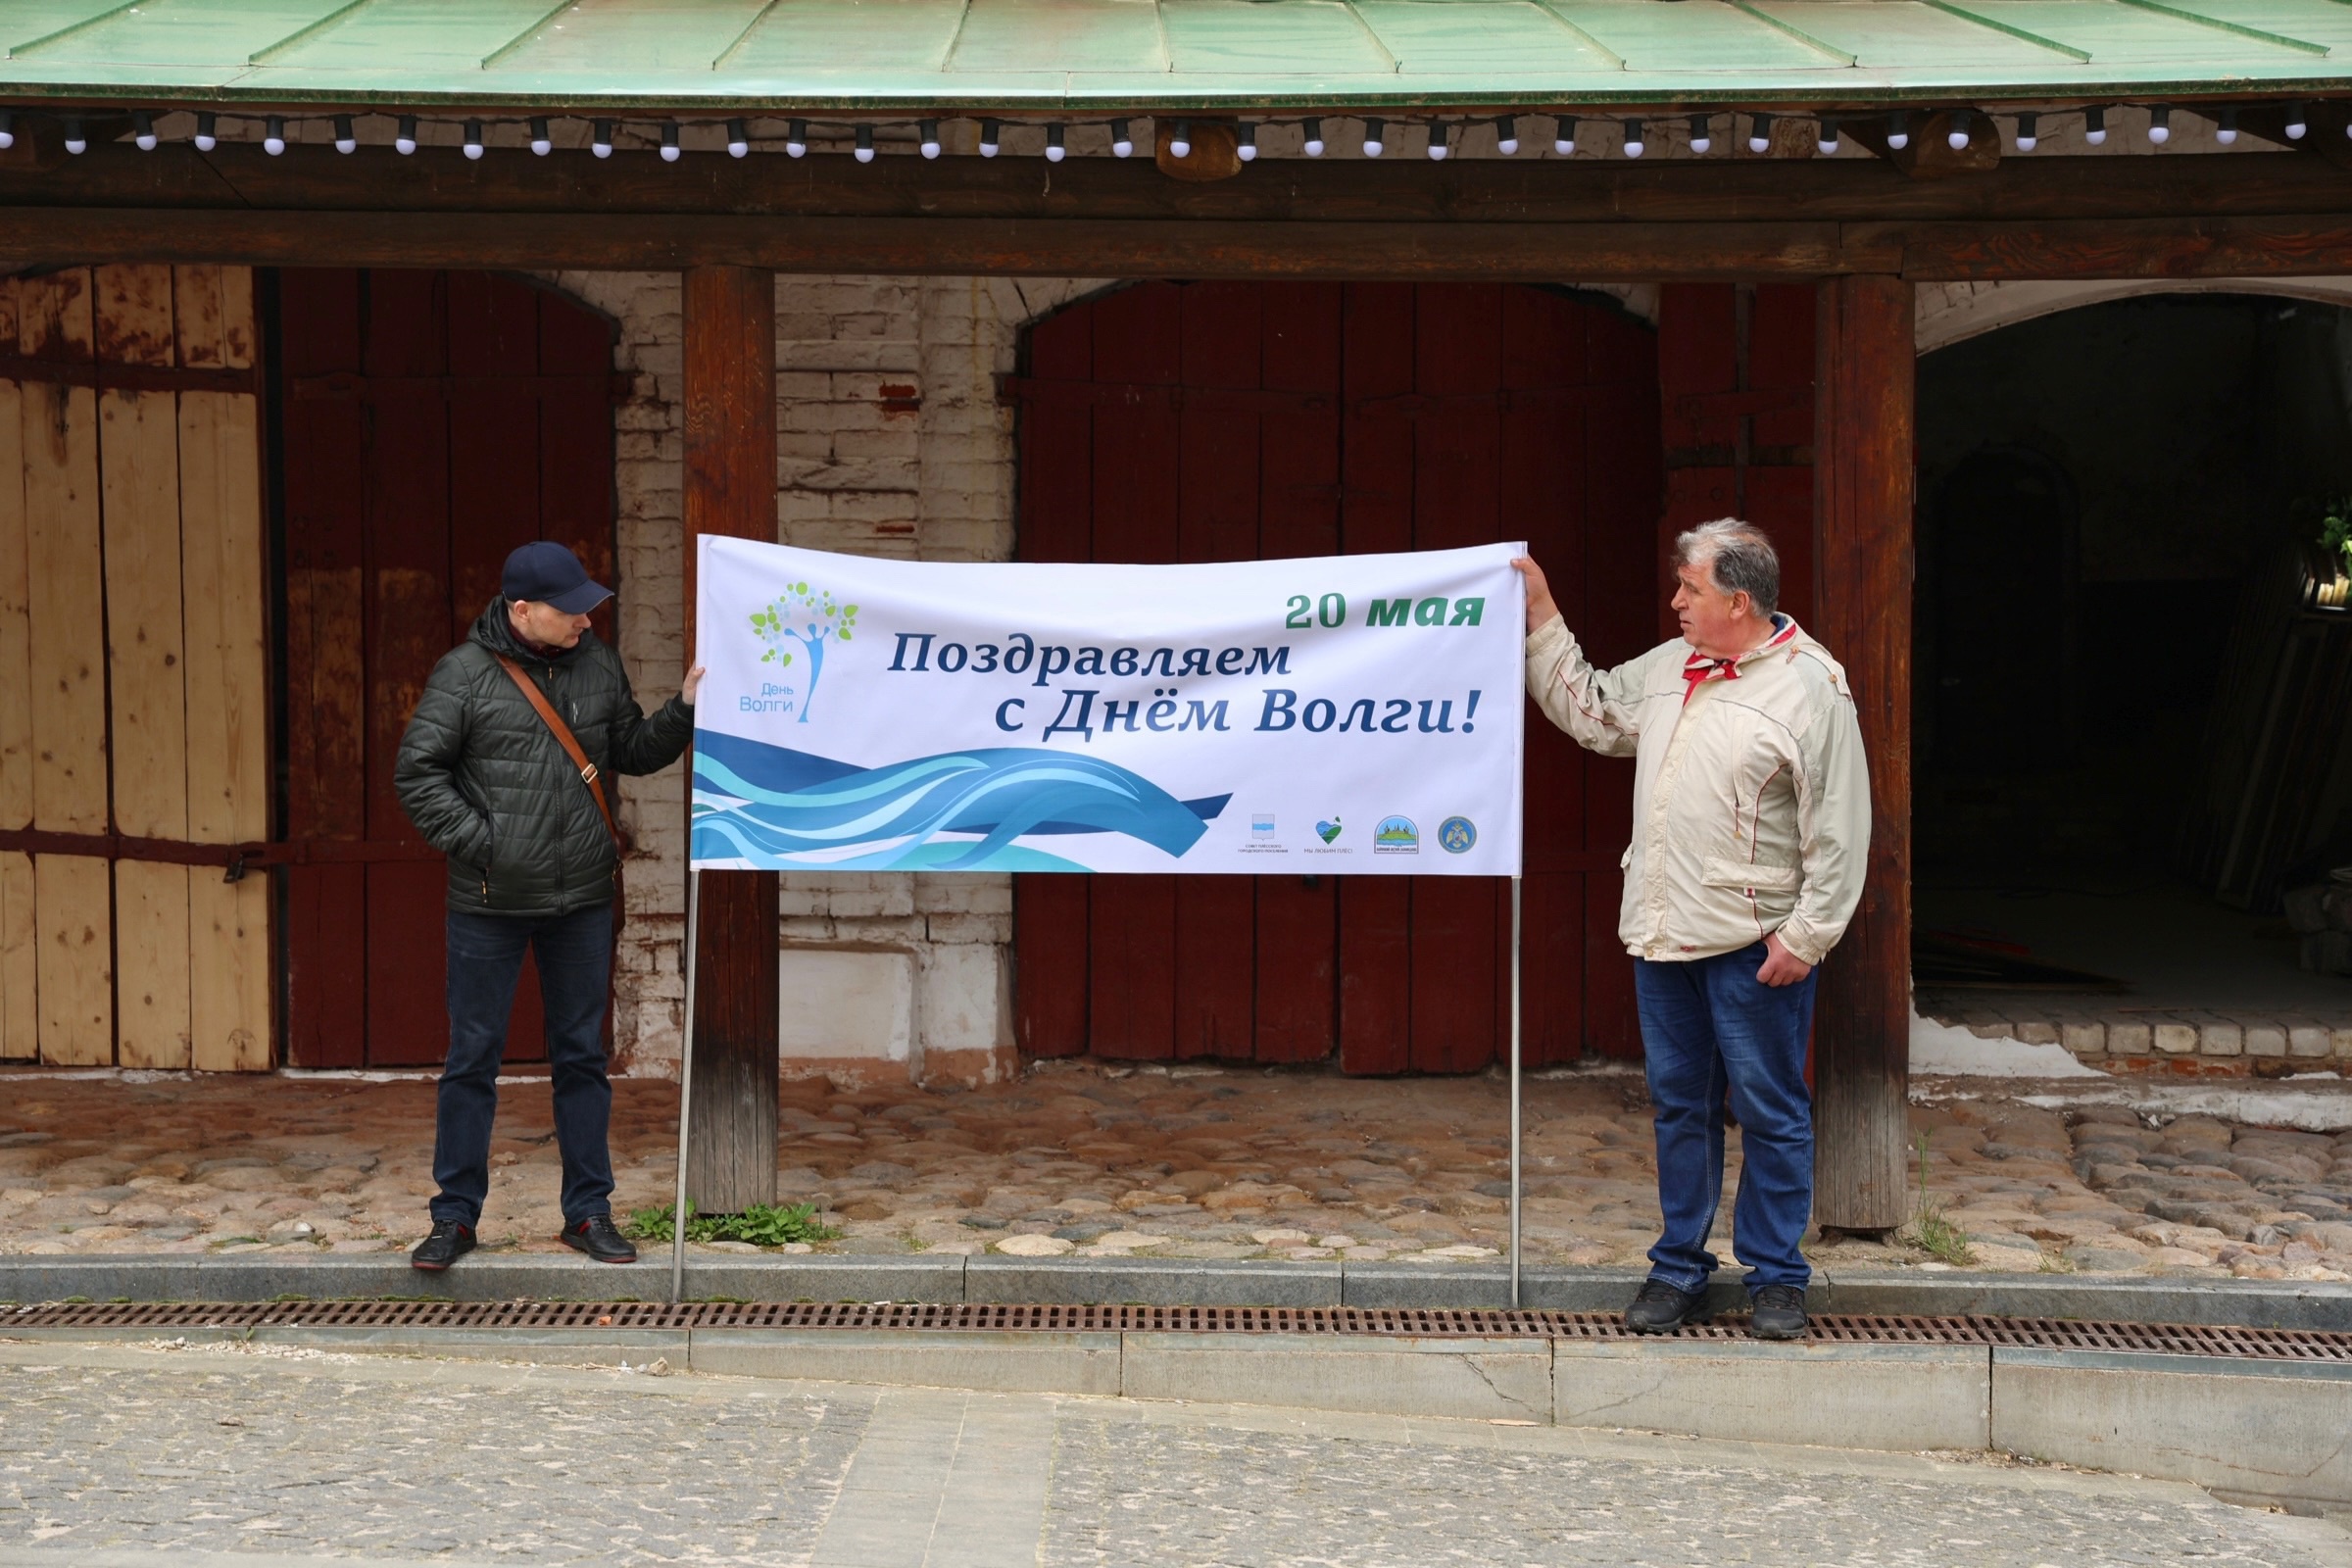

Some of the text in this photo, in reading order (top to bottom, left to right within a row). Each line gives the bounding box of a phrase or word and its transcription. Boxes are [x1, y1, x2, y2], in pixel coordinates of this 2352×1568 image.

[1285, 592, 1486, 629] 20 мая
[887, 633, 1292, 686] Поздравляем
[739, 696, 794, 712] Волги
[760, 683, 795, 697] День
[995, 688, 1483, 742] с Днём Волги!
